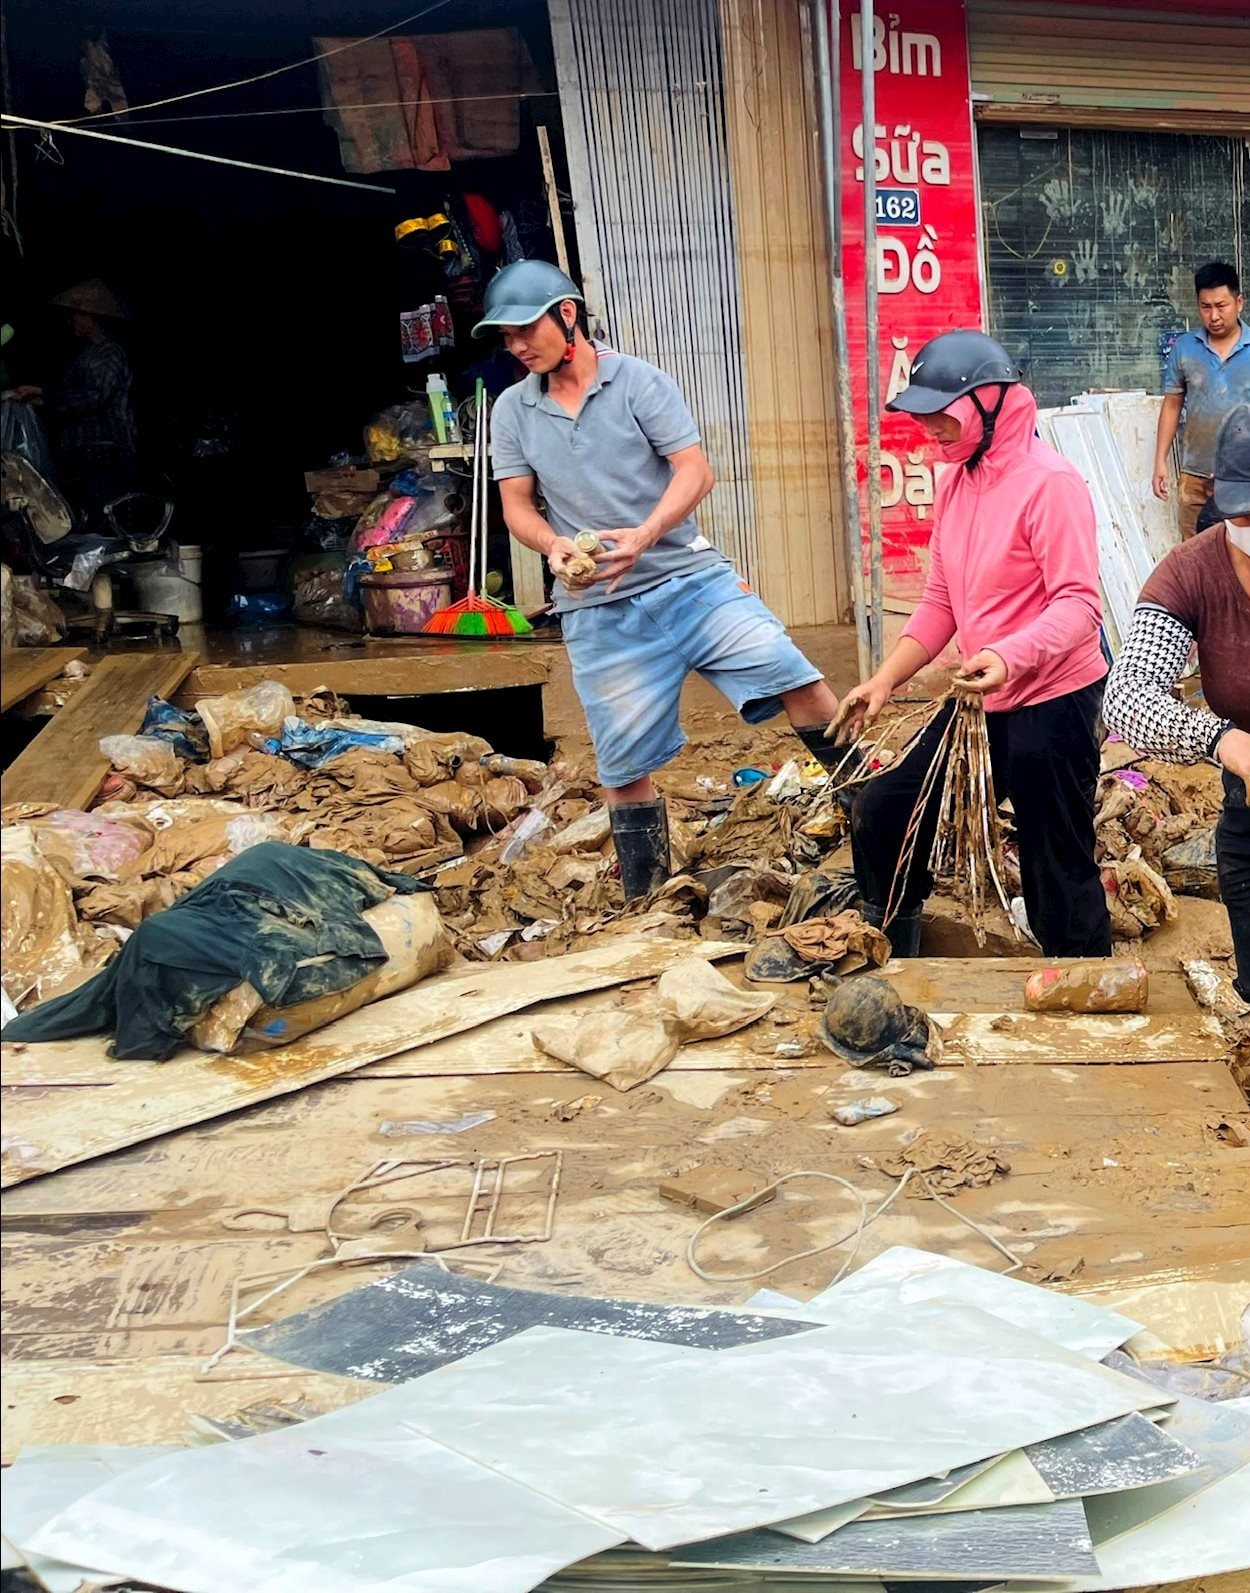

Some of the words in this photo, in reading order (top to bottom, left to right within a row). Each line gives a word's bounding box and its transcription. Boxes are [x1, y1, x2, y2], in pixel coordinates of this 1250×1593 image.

[851, 13, 942, 77] Bỉm
[852, 124, 951, 185] Sữa
[876, 196, 916, 218] 162
[876, 224, 942, 294] Đồ
[880, 451, 946, 520] Dặ
